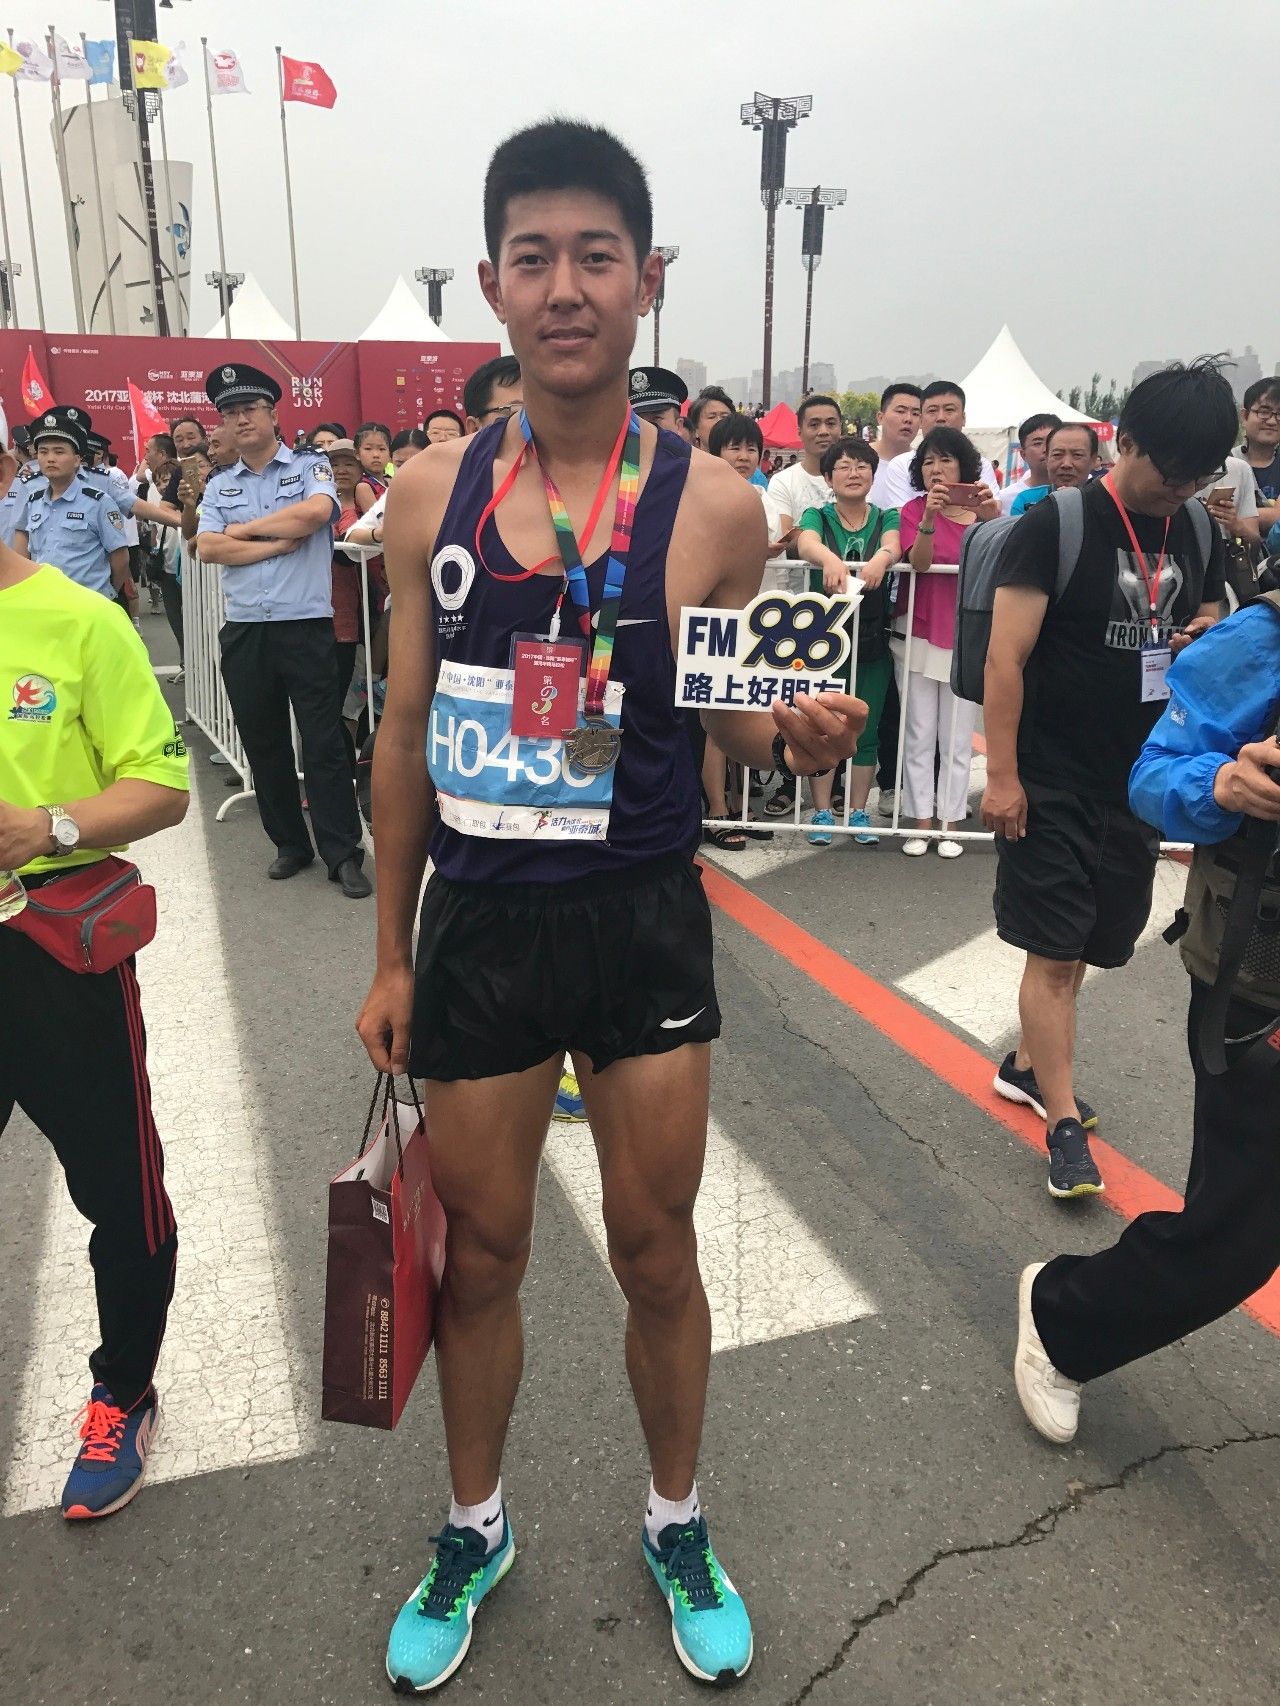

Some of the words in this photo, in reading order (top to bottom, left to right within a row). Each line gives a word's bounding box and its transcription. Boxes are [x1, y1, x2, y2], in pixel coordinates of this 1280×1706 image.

[292, 377, 322, 387] RUN
[292, 387, 322, 398] FOR
[293, 397, 324, 408] JOY
[686, 616, 738, 658] FM
